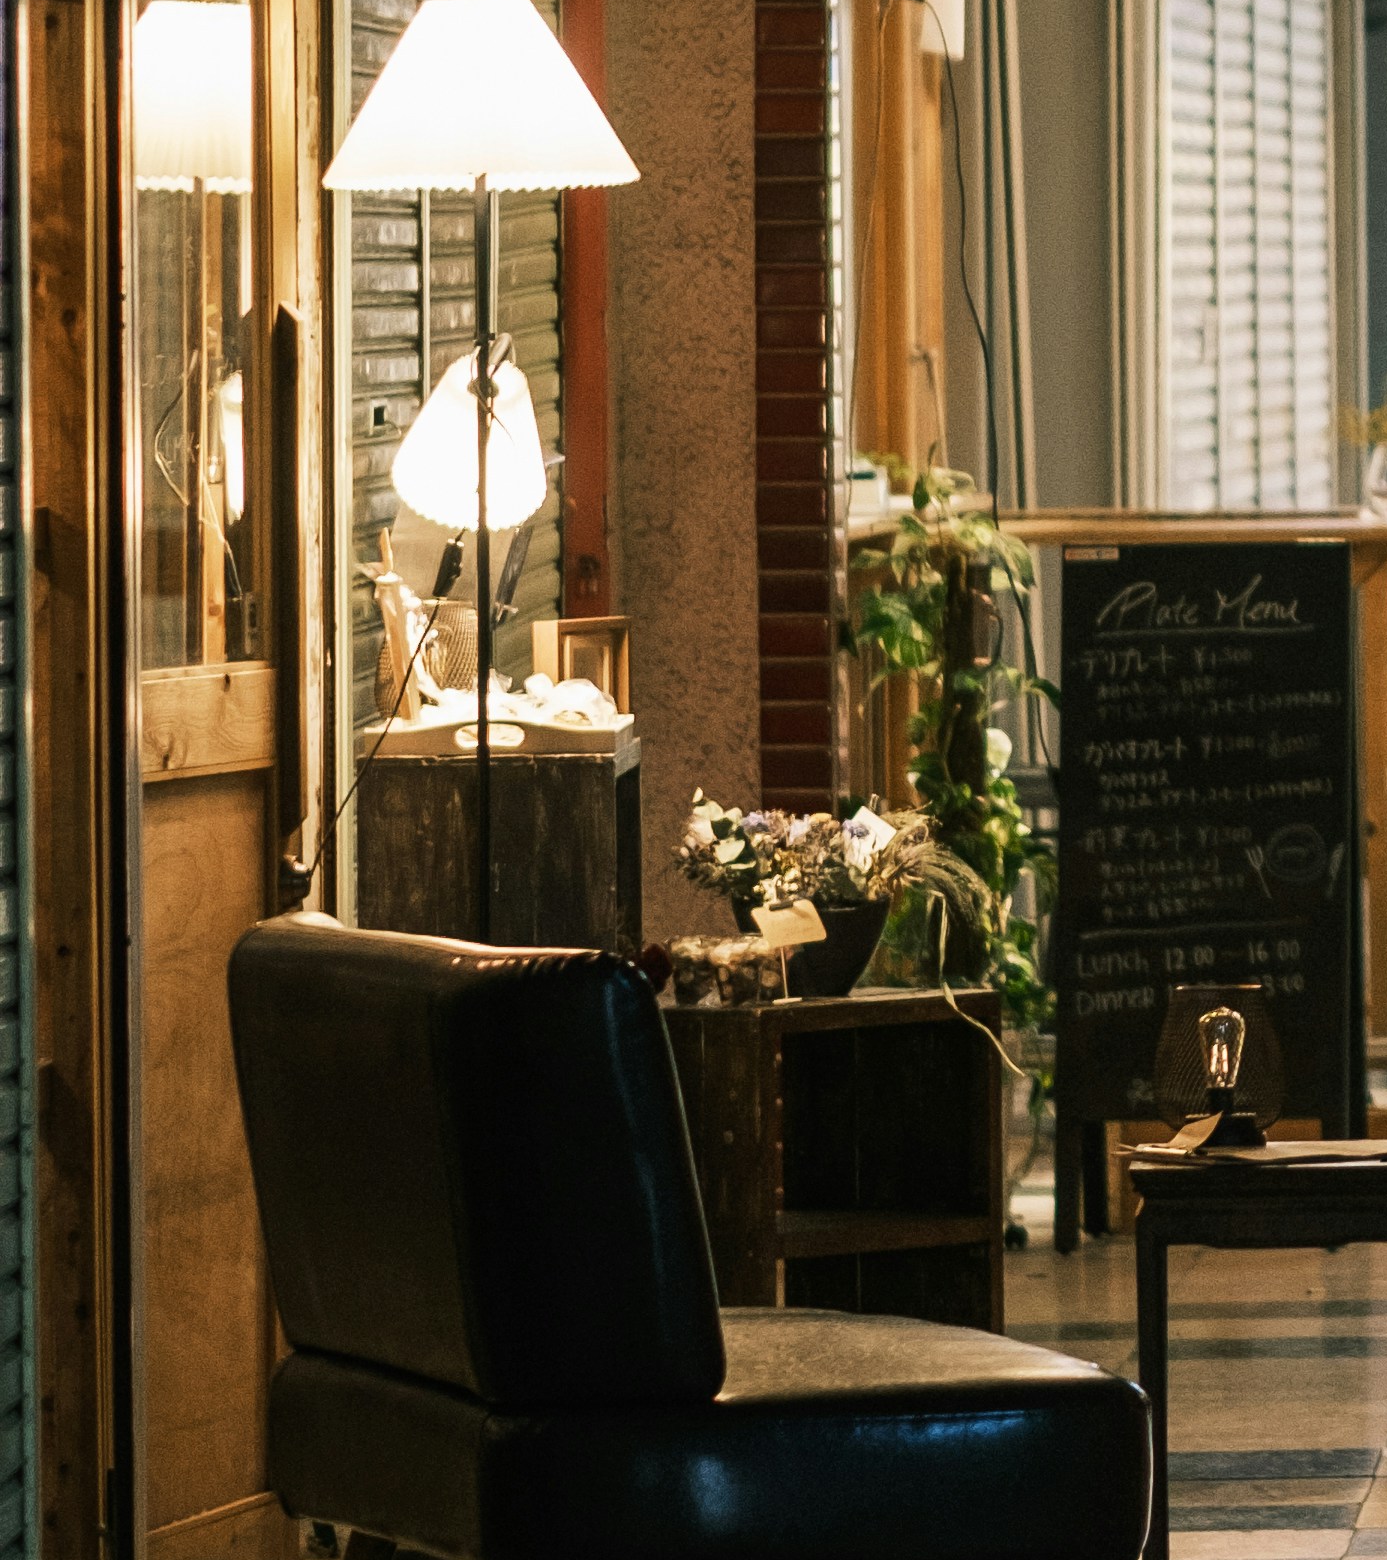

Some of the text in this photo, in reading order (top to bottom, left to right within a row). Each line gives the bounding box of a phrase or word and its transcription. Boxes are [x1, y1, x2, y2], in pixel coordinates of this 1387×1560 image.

[1096, 573, 1301, 631] Plate Menu
[1076, 947, 1150, 979] Lunch
